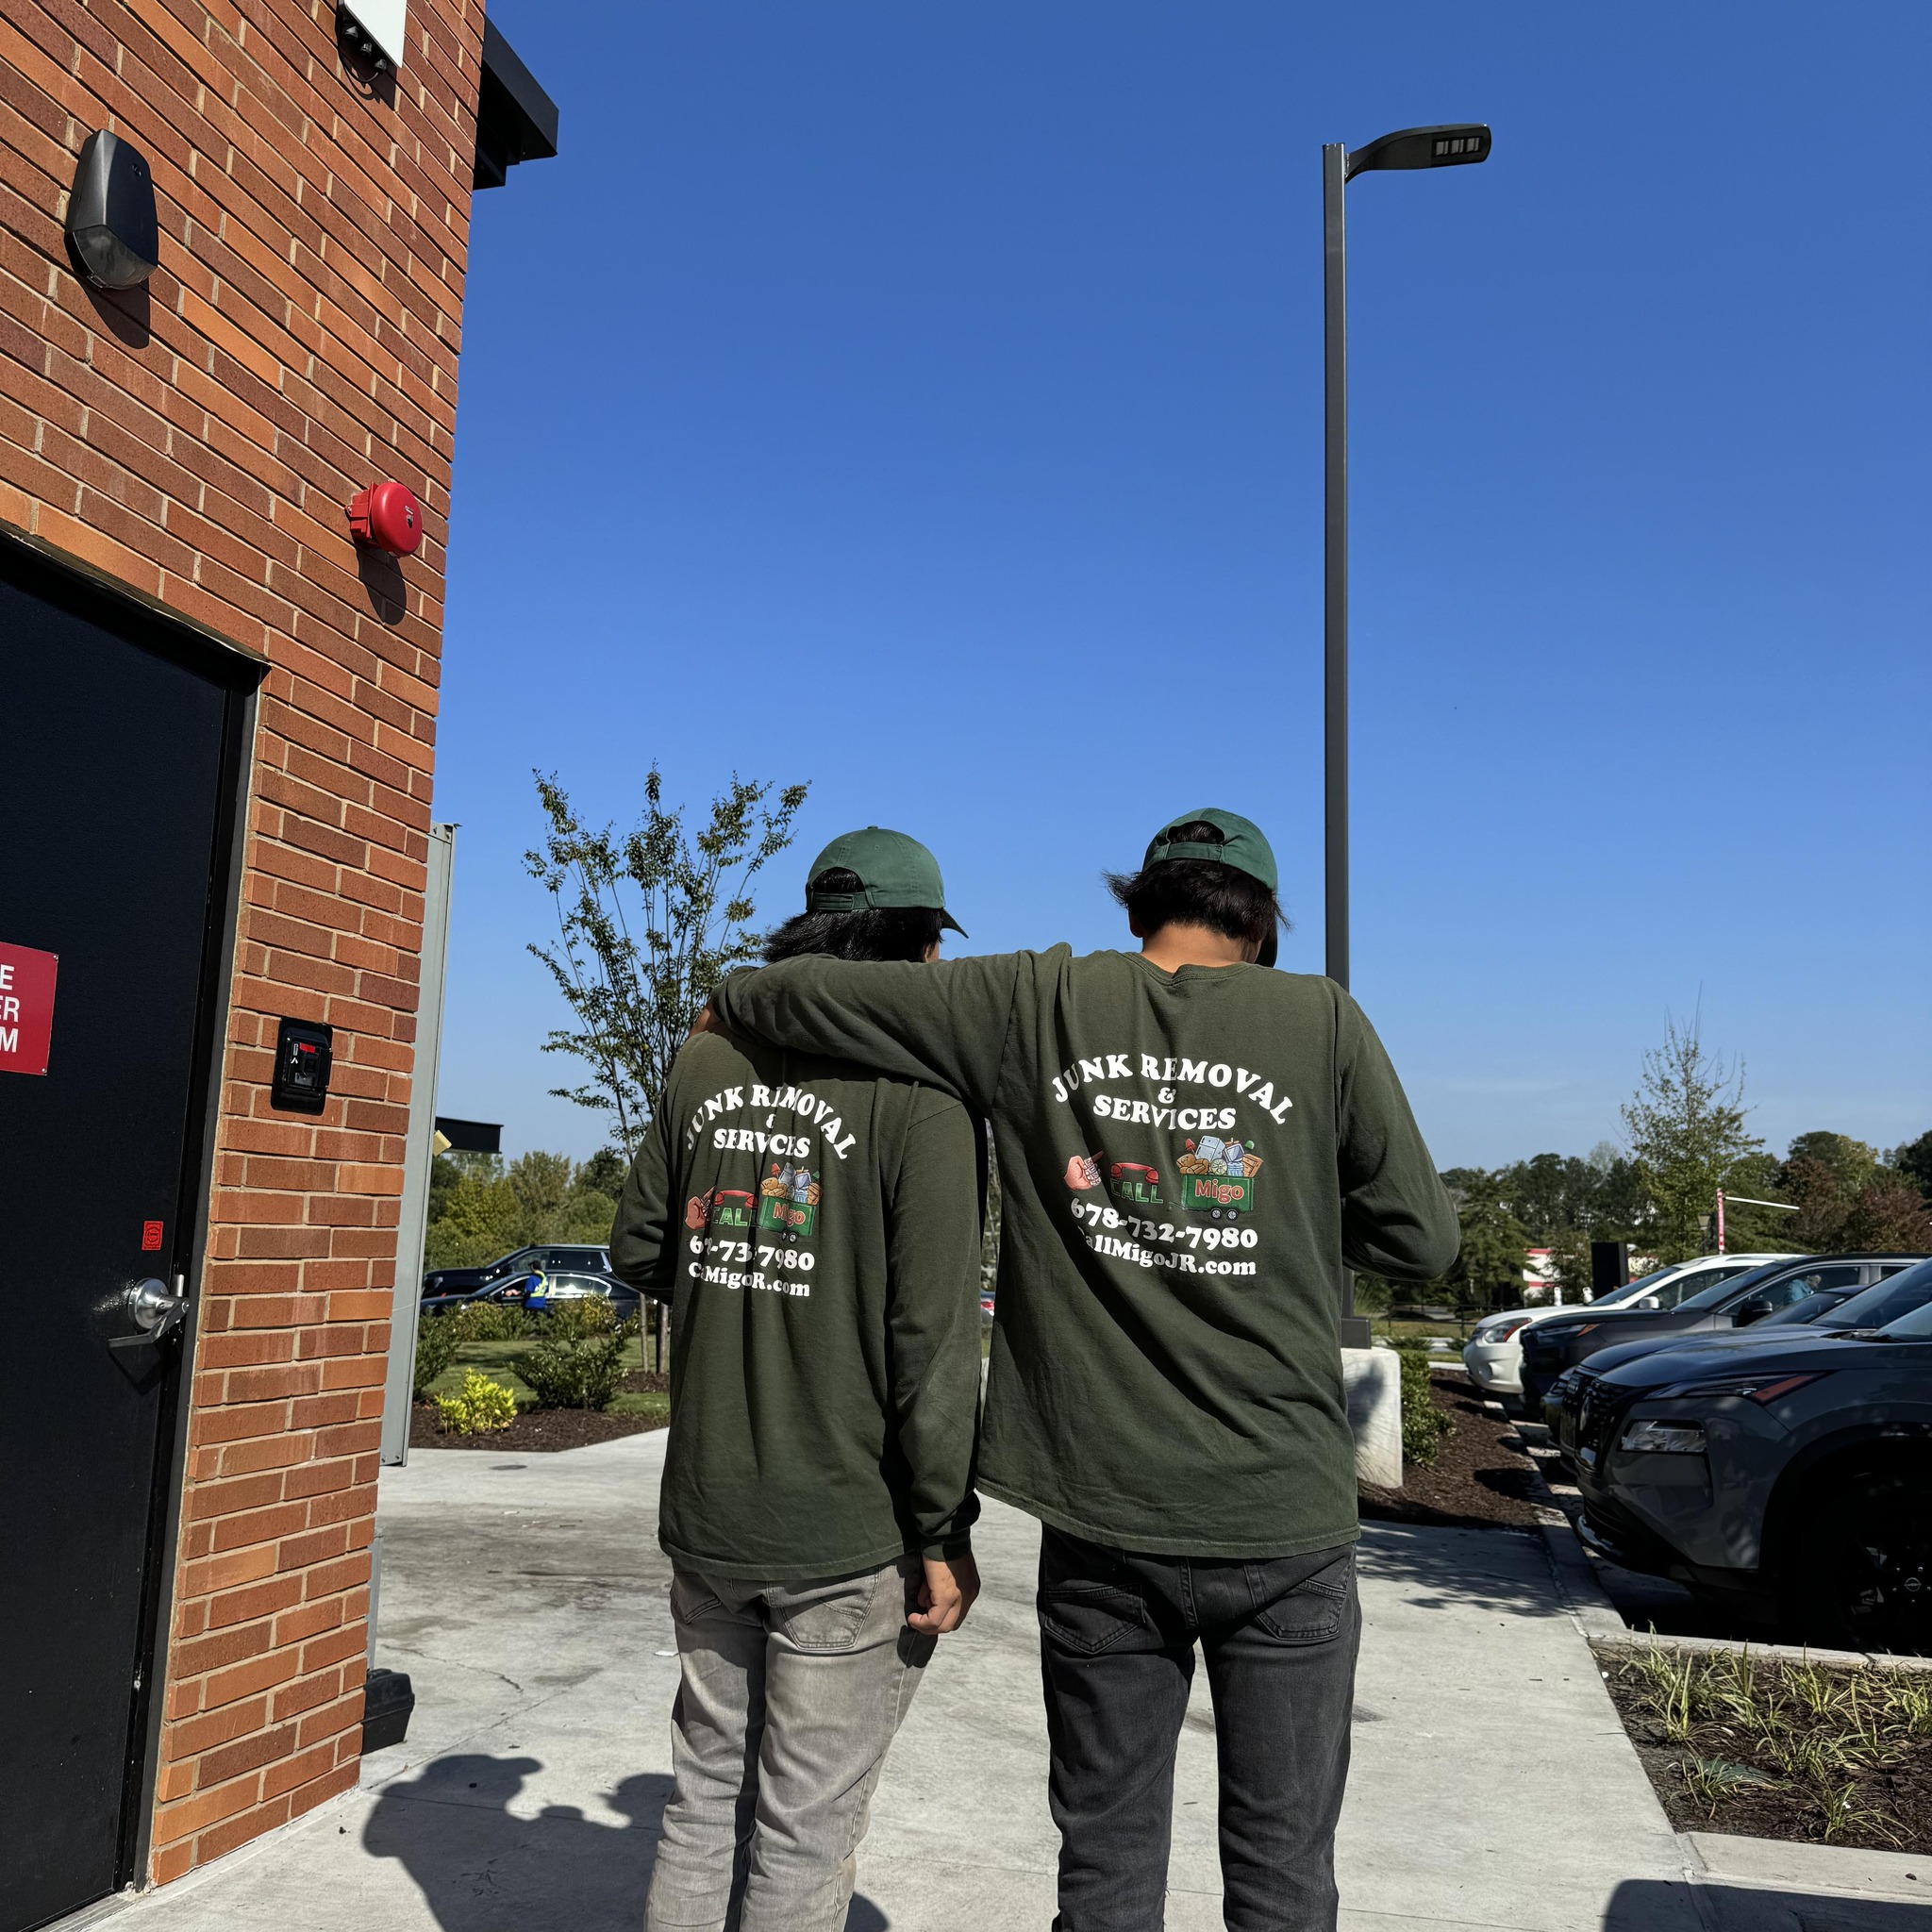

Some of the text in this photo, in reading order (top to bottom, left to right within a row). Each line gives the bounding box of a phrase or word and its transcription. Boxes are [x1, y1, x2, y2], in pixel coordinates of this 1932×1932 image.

[1052, 1053, 1293, 1125] JUNK REMOVAL
[1158, 1087, 1176, 1105] &
[686, 1086, 743, 1151] JUNK
[1092, 1094, 1237, 1131] SERVICES
[713, 1127, 811, 1158] SERVCES
[1109, 1177, 1244, 1205] CALL Migo
[773, 1201, 807, 1227] Mgo
[1071, 1197, 1258, 1252] 678-732-7980
[1077, 1225, 1257, 1276] allMigoJR.com
